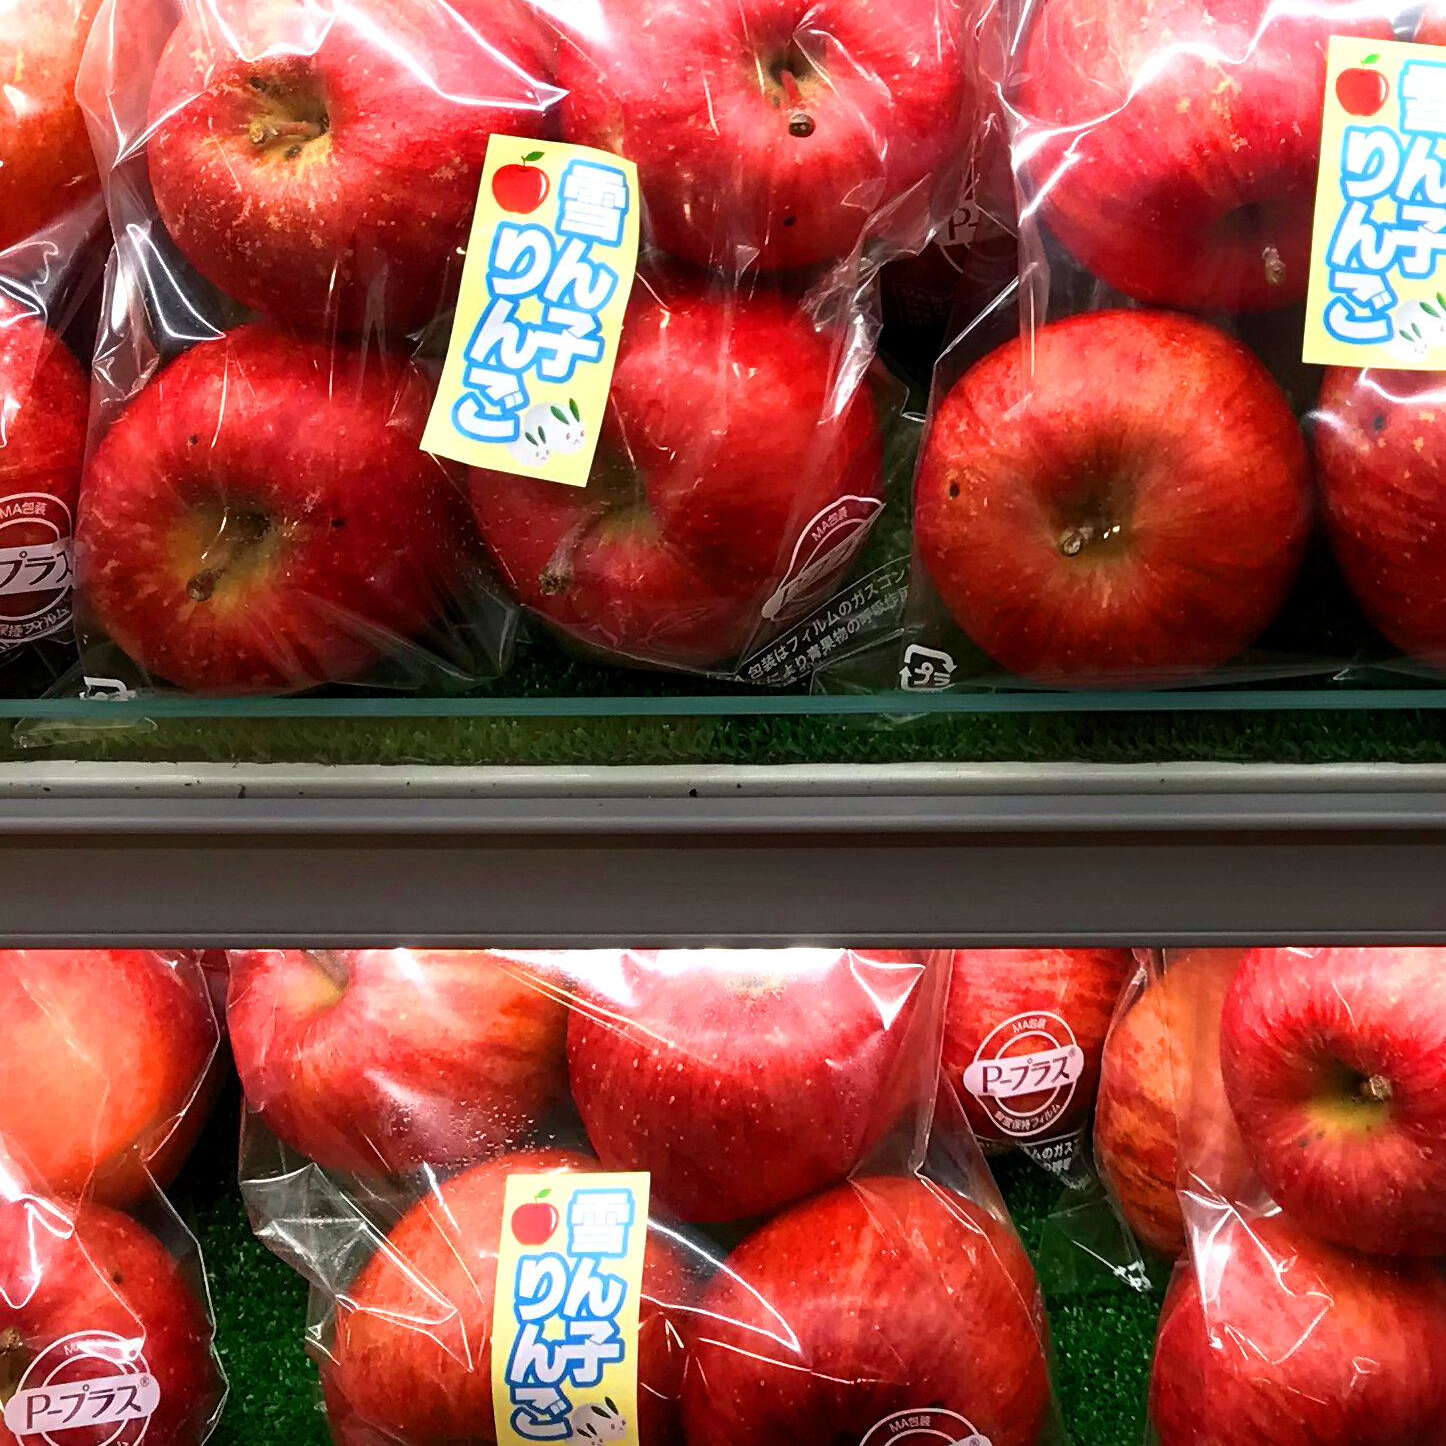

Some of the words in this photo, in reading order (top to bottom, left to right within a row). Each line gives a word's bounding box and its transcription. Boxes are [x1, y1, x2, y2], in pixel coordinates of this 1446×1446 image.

[452, 220, 556, 443] りんご
[538, 158, 629, 383] 雪ん子
[1323, 125, 1401, 345] りんご
[505, 1252, 573, 1440] りんご
[564, 1188, 635, 1388] 雪ん子
[26, 1383, 142, 1430] P-プラス
